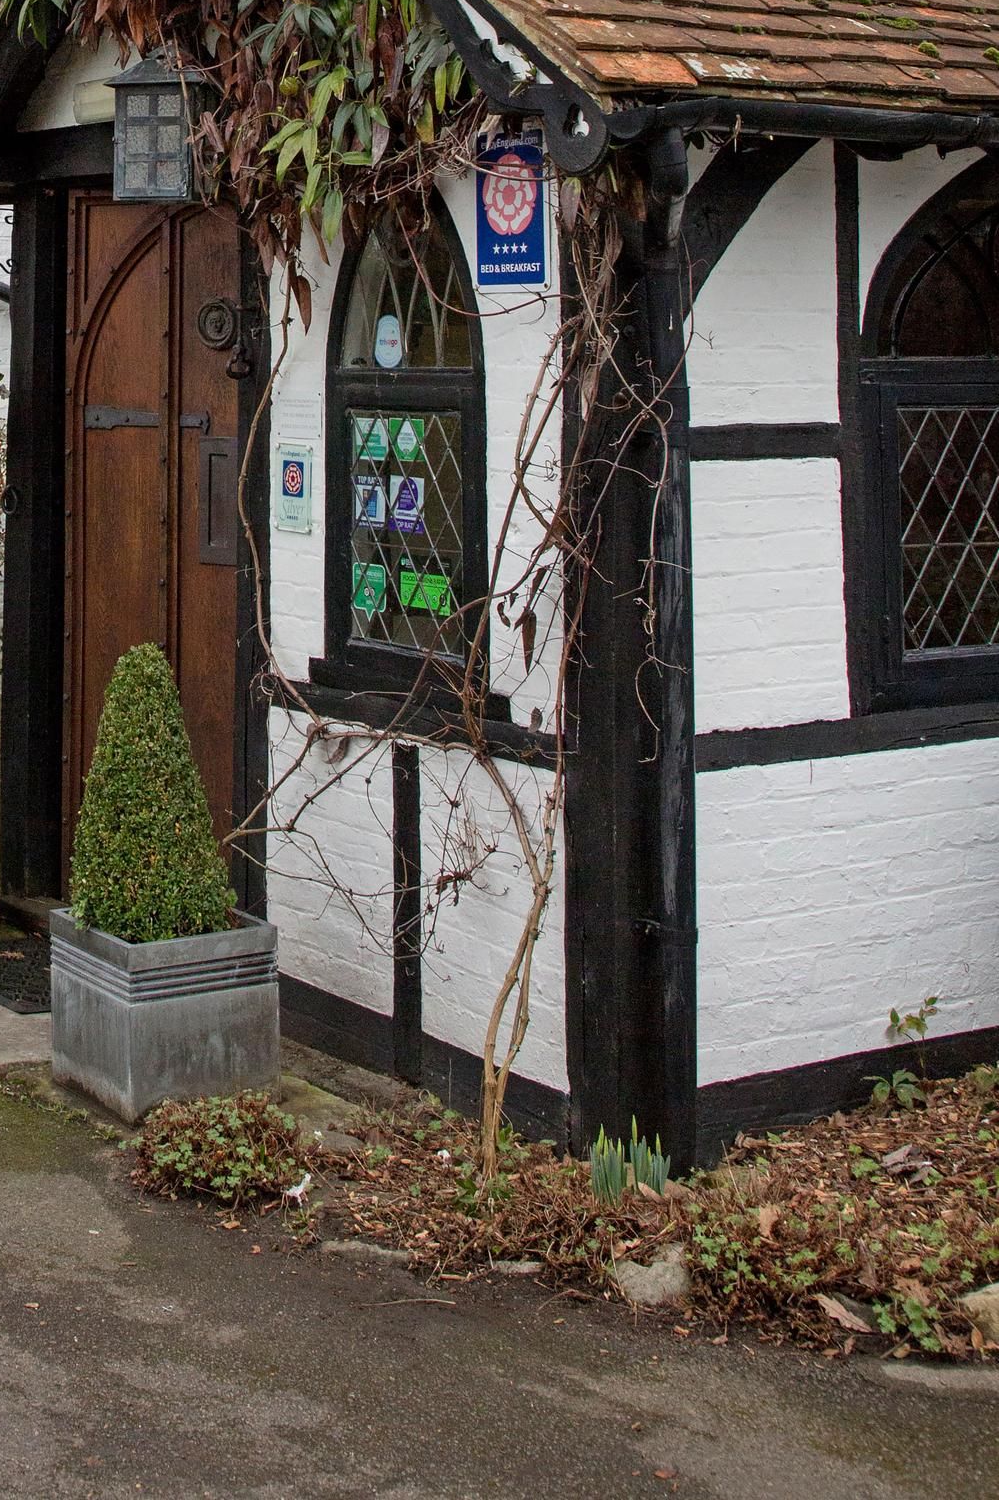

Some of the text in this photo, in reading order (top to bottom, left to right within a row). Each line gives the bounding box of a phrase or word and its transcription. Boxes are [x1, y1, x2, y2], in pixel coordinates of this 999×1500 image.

[480, 262, 541, 274] BED & BREAKFAST
